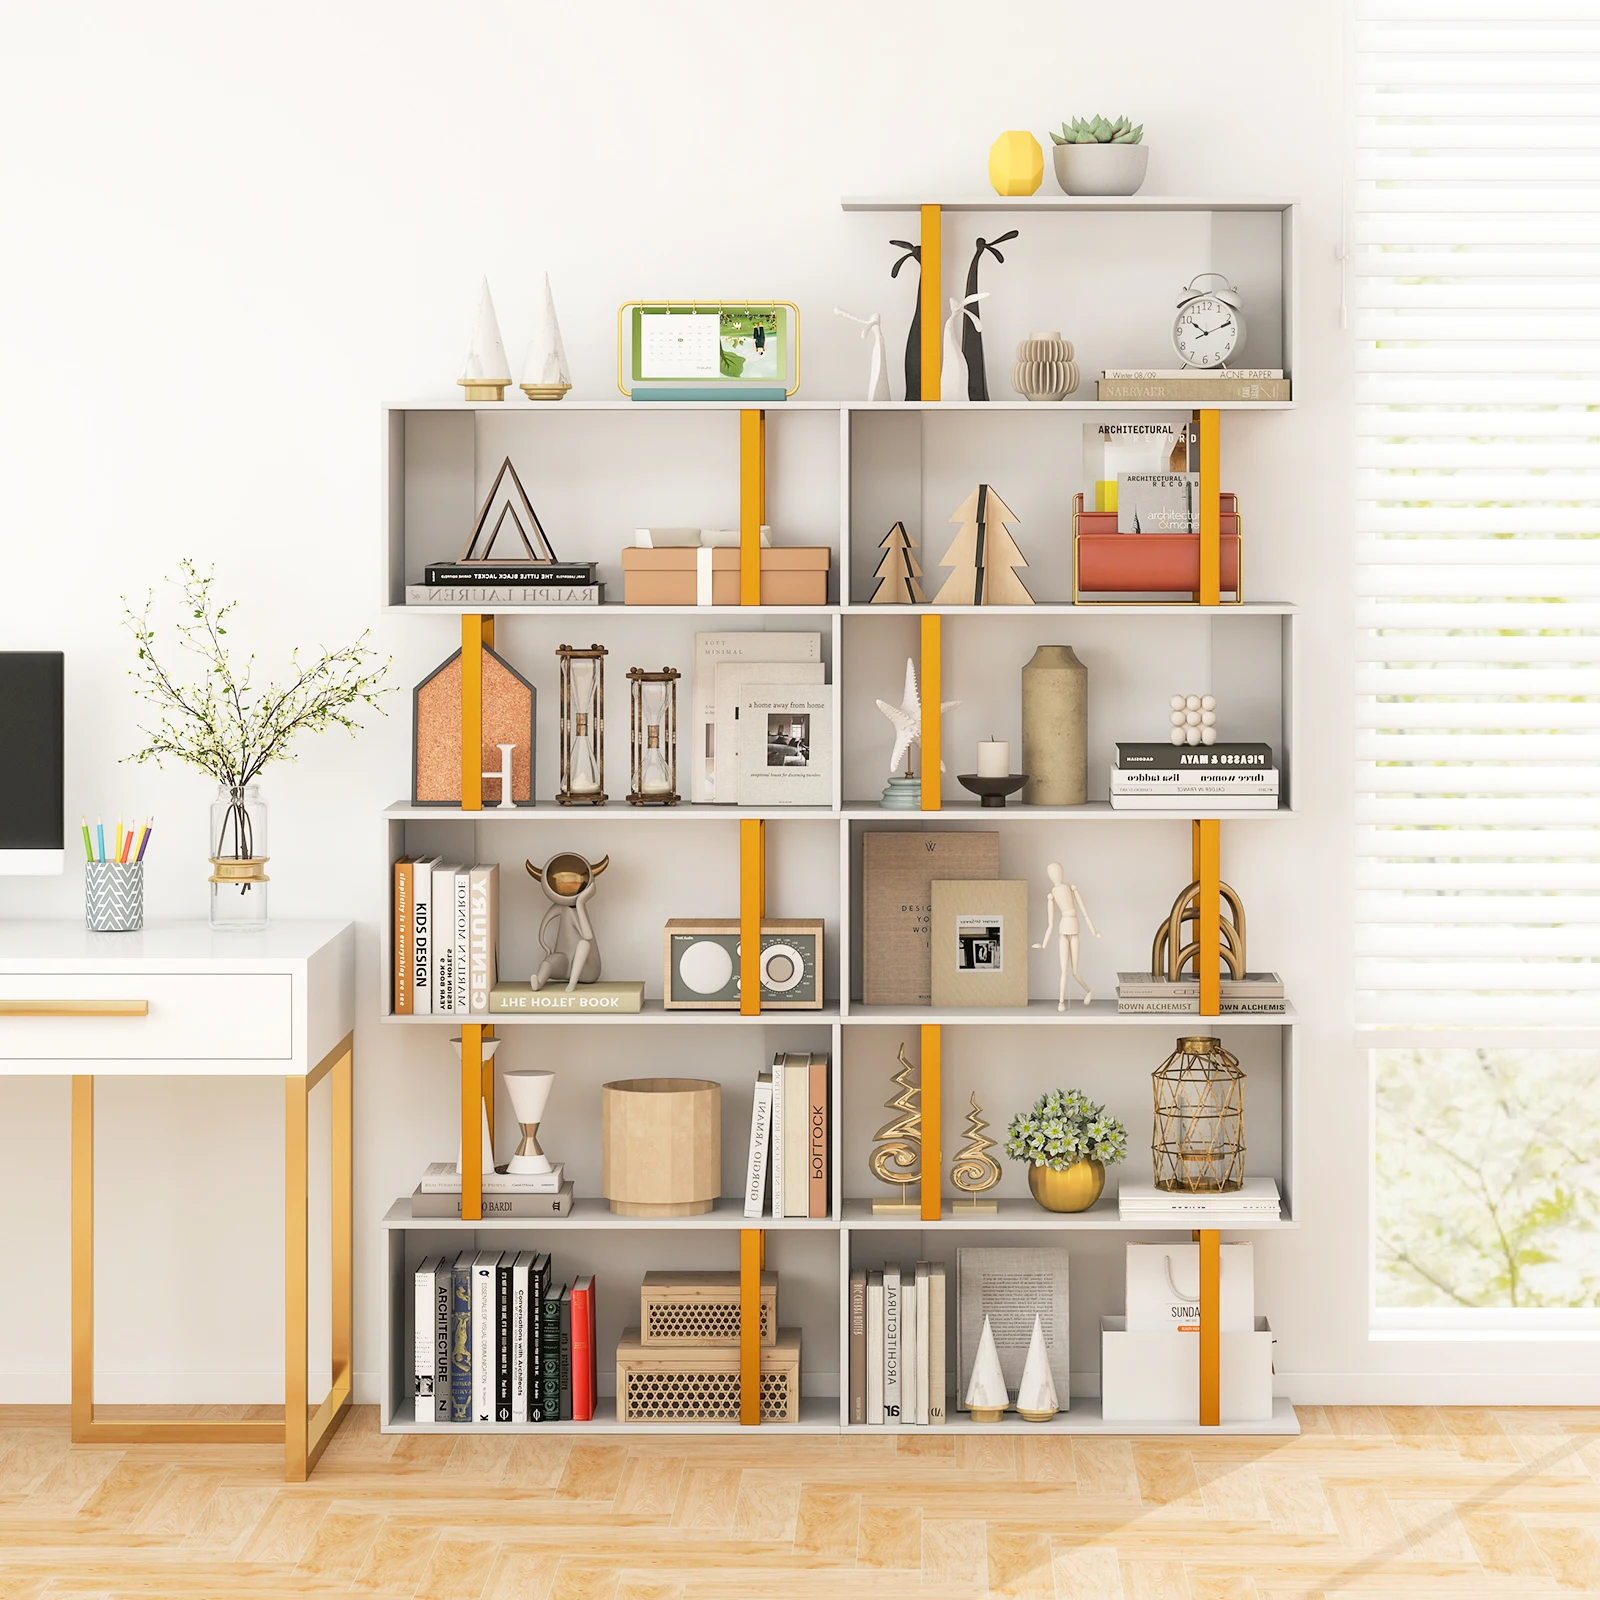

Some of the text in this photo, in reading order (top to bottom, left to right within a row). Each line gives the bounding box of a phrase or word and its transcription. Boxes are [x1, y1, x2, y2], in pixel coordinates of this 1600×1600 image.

[1191, 305, 1201, 314] 11
[1202, 302, 1213, 311] 12
[1216, 304, 1221, 313] 1
[1182, 315, 1192, 325] 10
[1226, 313, 1232, 322] 2
[1177, 327, 1183, 336] 9
[1230, 327, 1236, 336] 3
[1180, 341, 1186, 351] 8
[1224, 342, 1231, 351] 4
[1189, 351, 1195, 360] 7
[1202, 355, 1208, 364] 6
[1214, 352, 1220, 361] 5
[1112, 371, 1133, 379] Winter
[1220, 370, 1272, 379] ACNE PAPER
[1098, 425, 1174, 434] ARCHITECTURAL
[1133, 434, 1197, 443] REORD
[1147, 506, 1200, 520] architectur
[790, 701, 805, 709] from
[398, 872, 406, 913] simplicity
[399, 914, 406, 922] is
[399, 924, 406, 932] in
[416, 903, 427, 987] KIDS DESIGN
[398, 934, 406, 978] everything
[399, 979, 405, 990] we
[489, 1202, 512, 1212] BARDI
[1171, 1306, 1200, 1318] SUNDA
[438, 1286, 448, 1382] ARCHITECTURE
